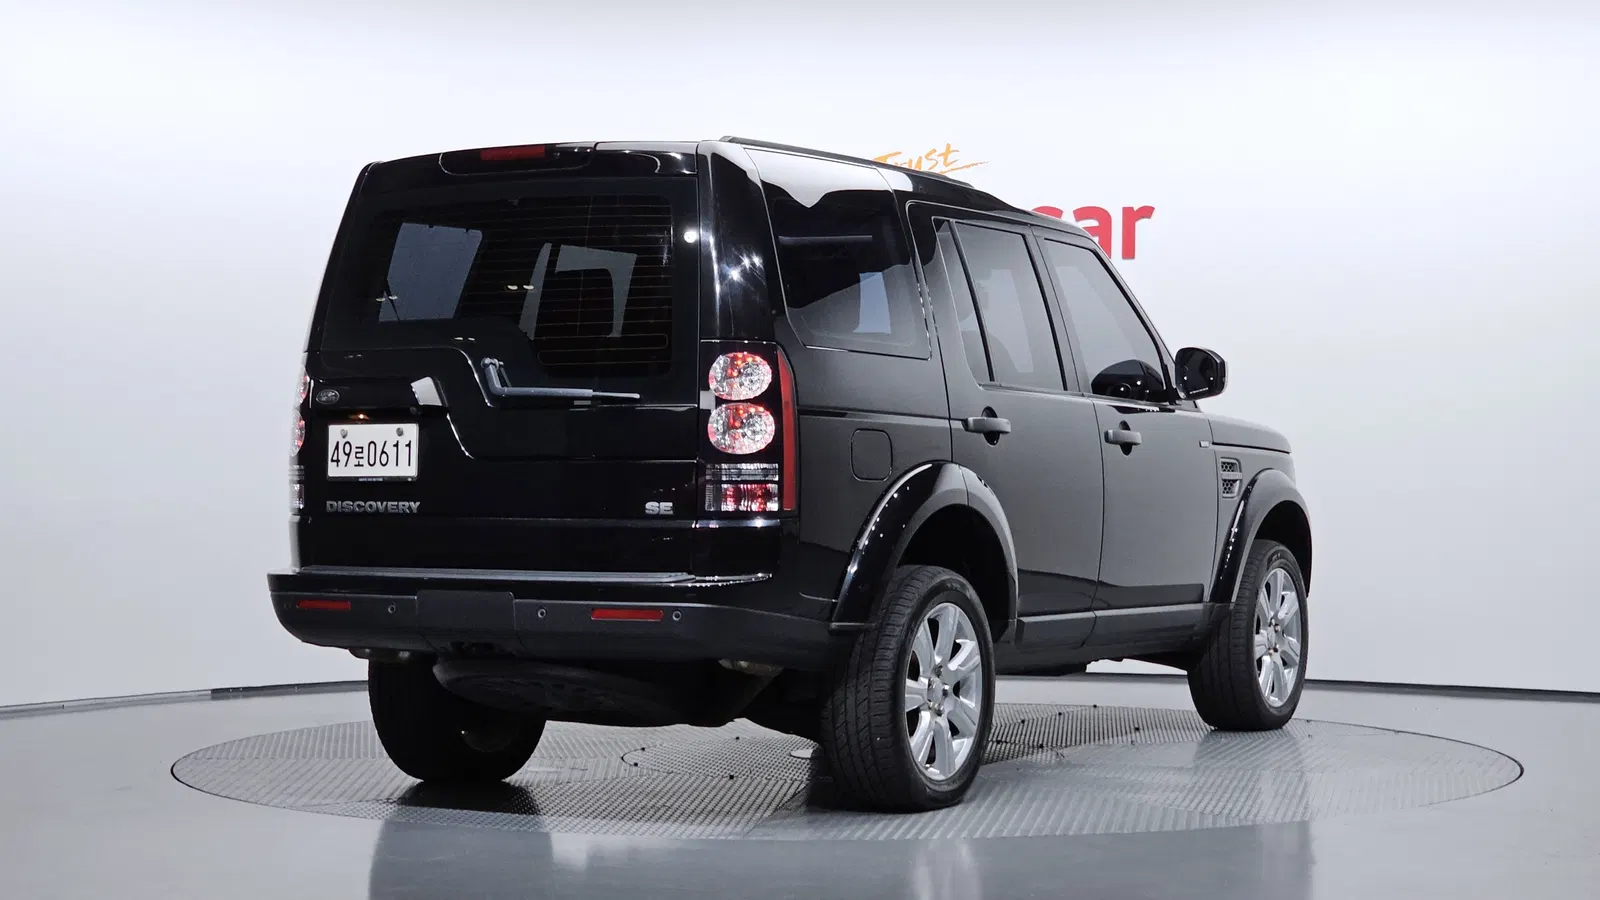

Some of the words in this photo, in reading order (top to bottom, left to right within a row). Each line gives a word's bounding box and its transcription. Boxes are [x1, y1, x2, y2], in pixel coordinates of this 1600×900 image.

[330, 440, 412, 468] 49로0611
[325, 500, 421, 514] DISCOVERY
[644, 501, 674, 515] SE
